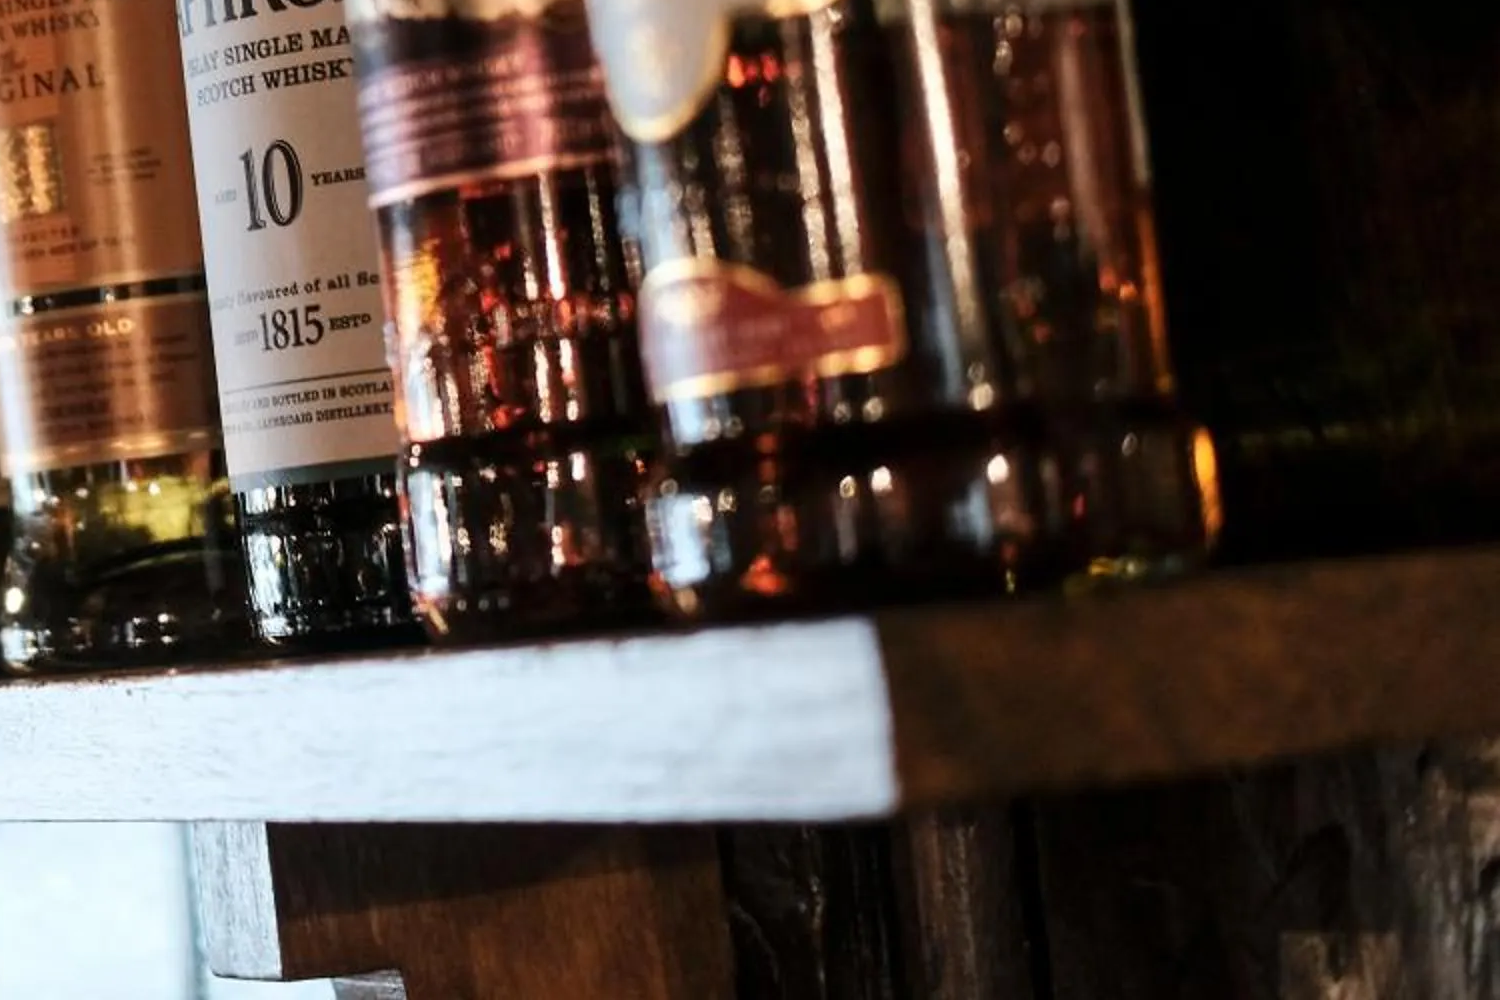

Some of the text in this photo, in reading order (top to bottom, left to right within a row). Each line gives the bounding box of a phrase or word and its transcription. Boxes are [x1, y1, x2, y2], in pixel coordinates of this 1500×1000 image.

[224, 32, 303, 67] SINGLE
[239, 138, 303, 232] 10
[303, 277, 322, 295] of
[327, 274, 350, 290] all
[259, 304, 325, 352] 1815
[321, 385, 337, 400] IN
